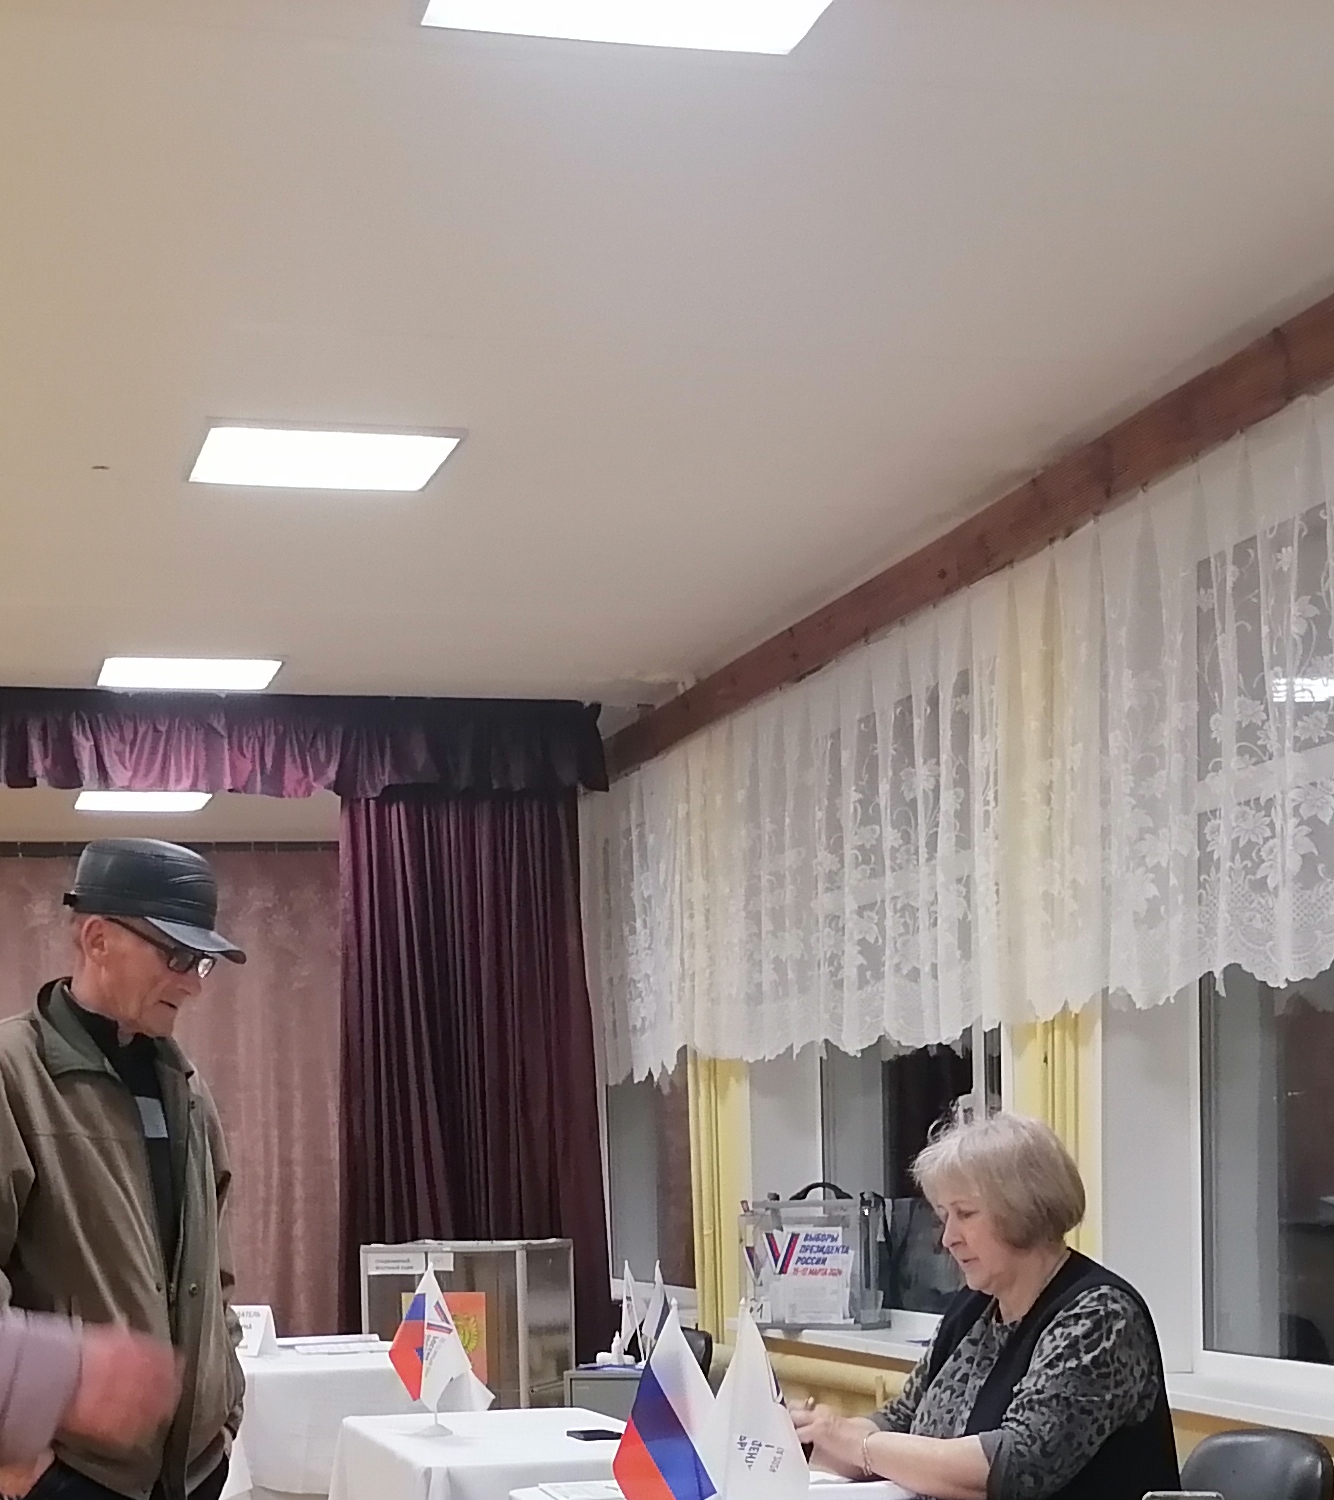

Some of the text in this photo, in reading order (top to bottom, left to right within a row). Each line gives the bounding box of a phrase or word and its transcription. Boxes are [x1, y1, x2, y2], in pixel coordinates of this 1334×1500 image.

[803, 1233, 839, 1242] ВЫБОРЫ
[799, 1244, 849, 1254] ПРЕЗИДЕНТА
[795, 1256, 828, 1265] РОССИИ
